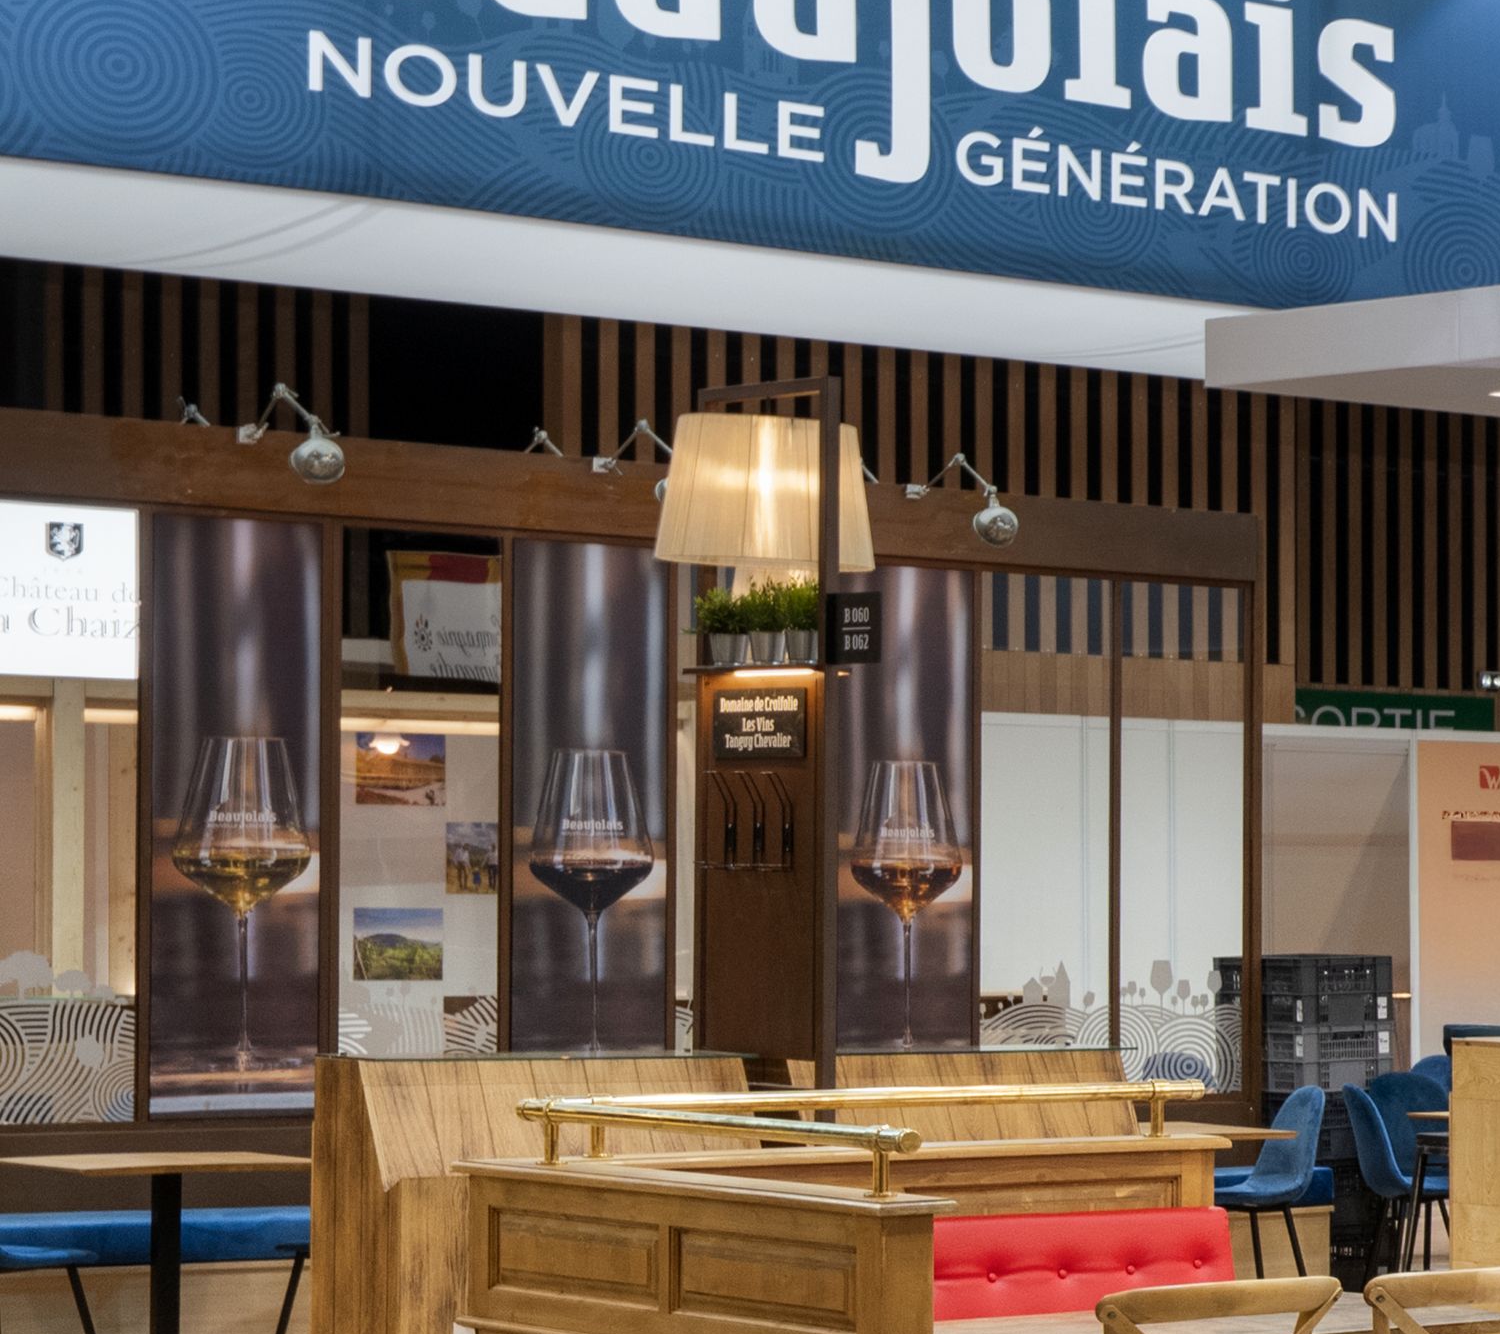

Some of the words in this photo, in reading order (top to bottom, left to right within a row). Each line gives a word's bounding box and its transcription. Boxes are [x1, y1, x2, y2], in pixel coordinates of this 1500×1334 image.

[306, 29, 825, 163] NOUVELLE
[954, 125, 1399, 243] GÉNÉRATION
[720, 696, 753, 713] Domaine
[754, 696, 764, 712] de
[742, 717, 755, 732] Les
[756, 716, 775, 732] Vins
[725, 733, 753, 751] Tanguy
[754, 732, 792, 748] Chevalier
